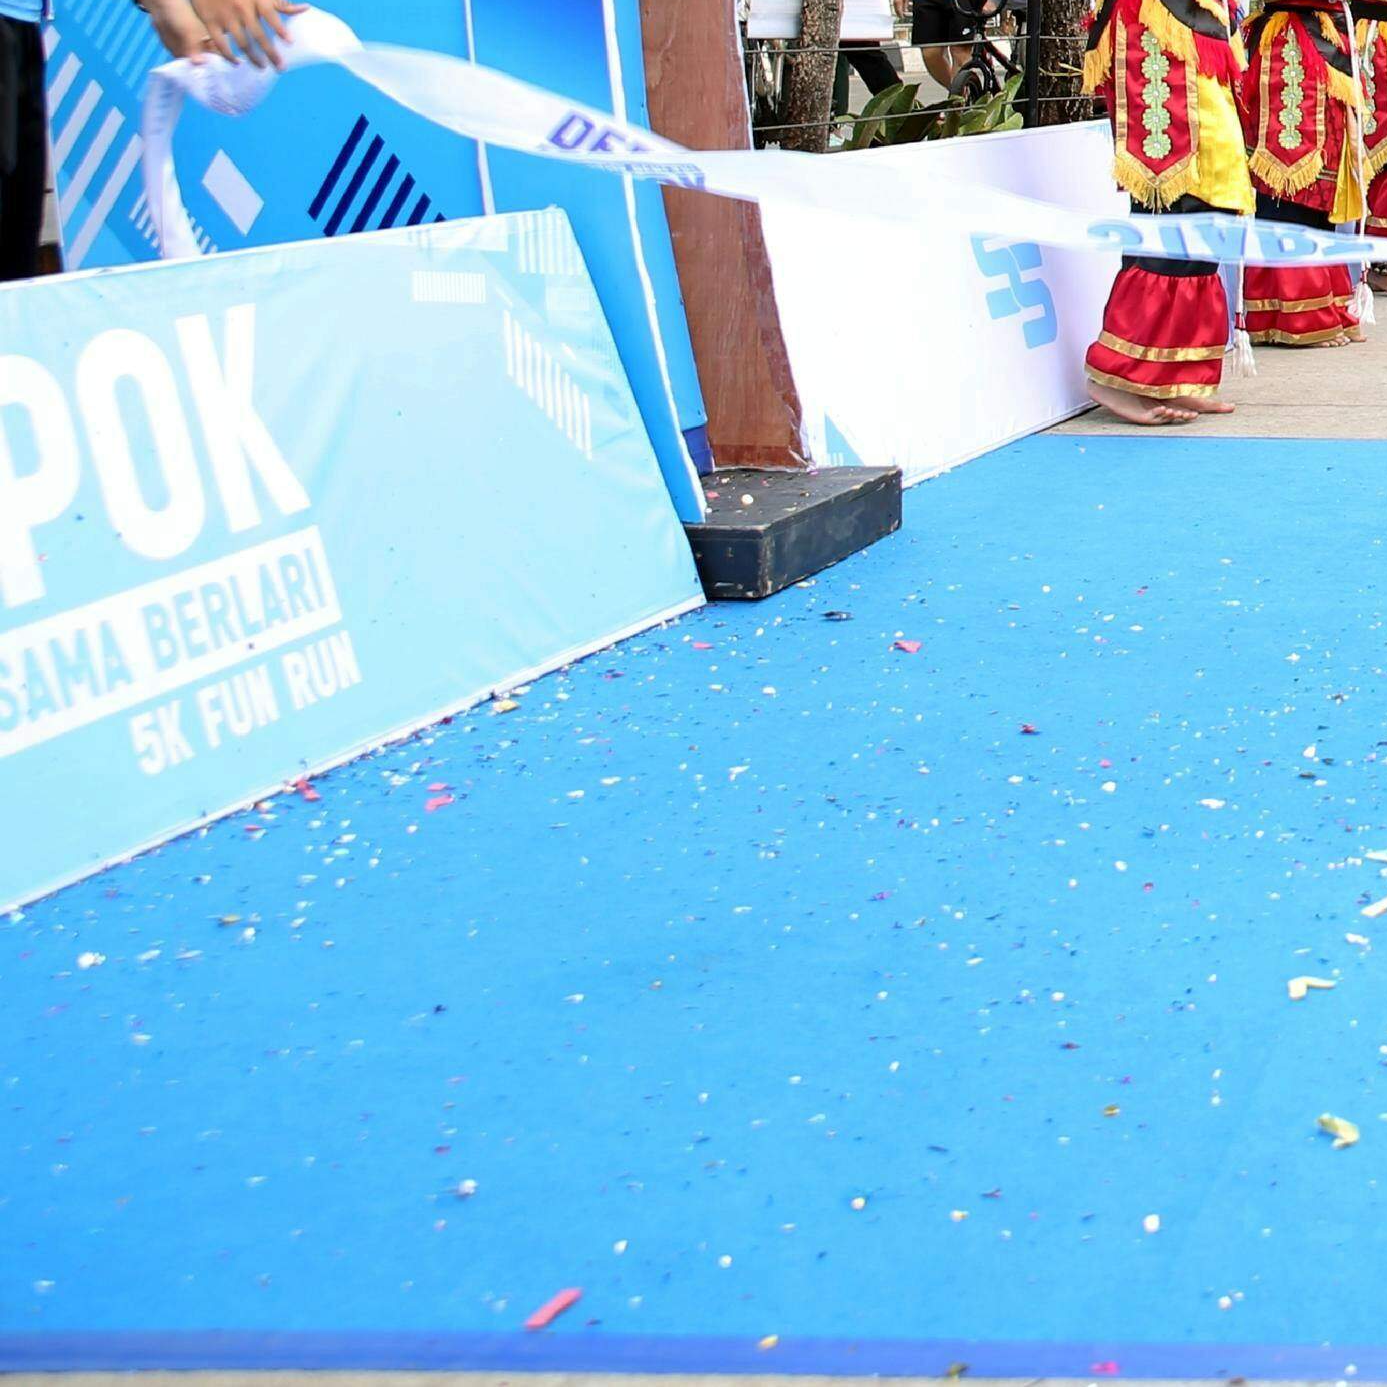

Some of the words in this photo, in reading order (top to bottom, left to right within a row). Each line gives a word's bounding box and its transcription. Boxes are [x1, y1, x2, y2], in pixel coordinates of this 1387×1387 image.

[140, 546, 327, 673] BERLARI
[128, 699, 195, 777] 5K
[198, 663, 280, 750] FUN
[282, 629, 362, 711] RUN
